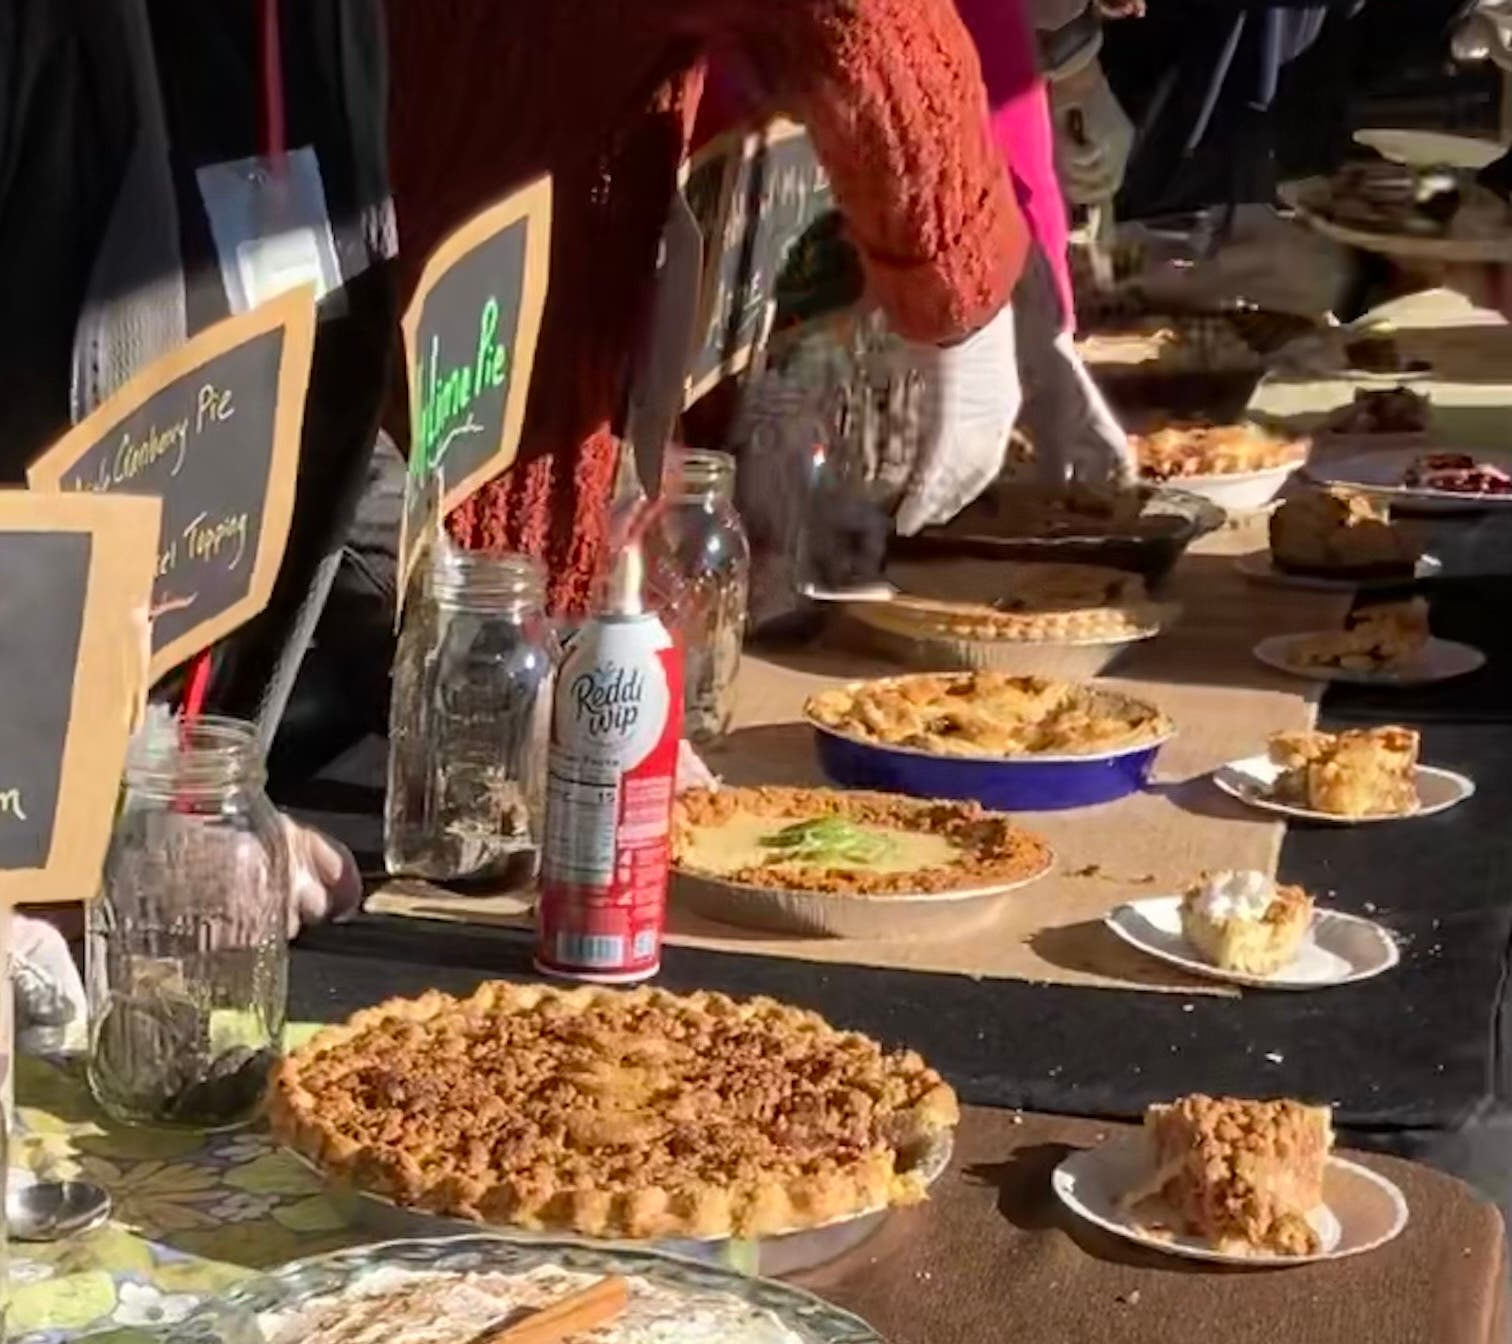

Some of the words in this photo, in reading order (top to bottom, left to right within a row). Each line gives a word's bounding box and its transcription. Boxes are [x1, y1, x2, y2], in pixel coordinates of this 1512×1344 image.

[474, 296, 506, 396] Pie
[196, 383, 236, 435] Pie
[570, 667, 644, 723] Reddi
[588, 703, 639, 737] wip
